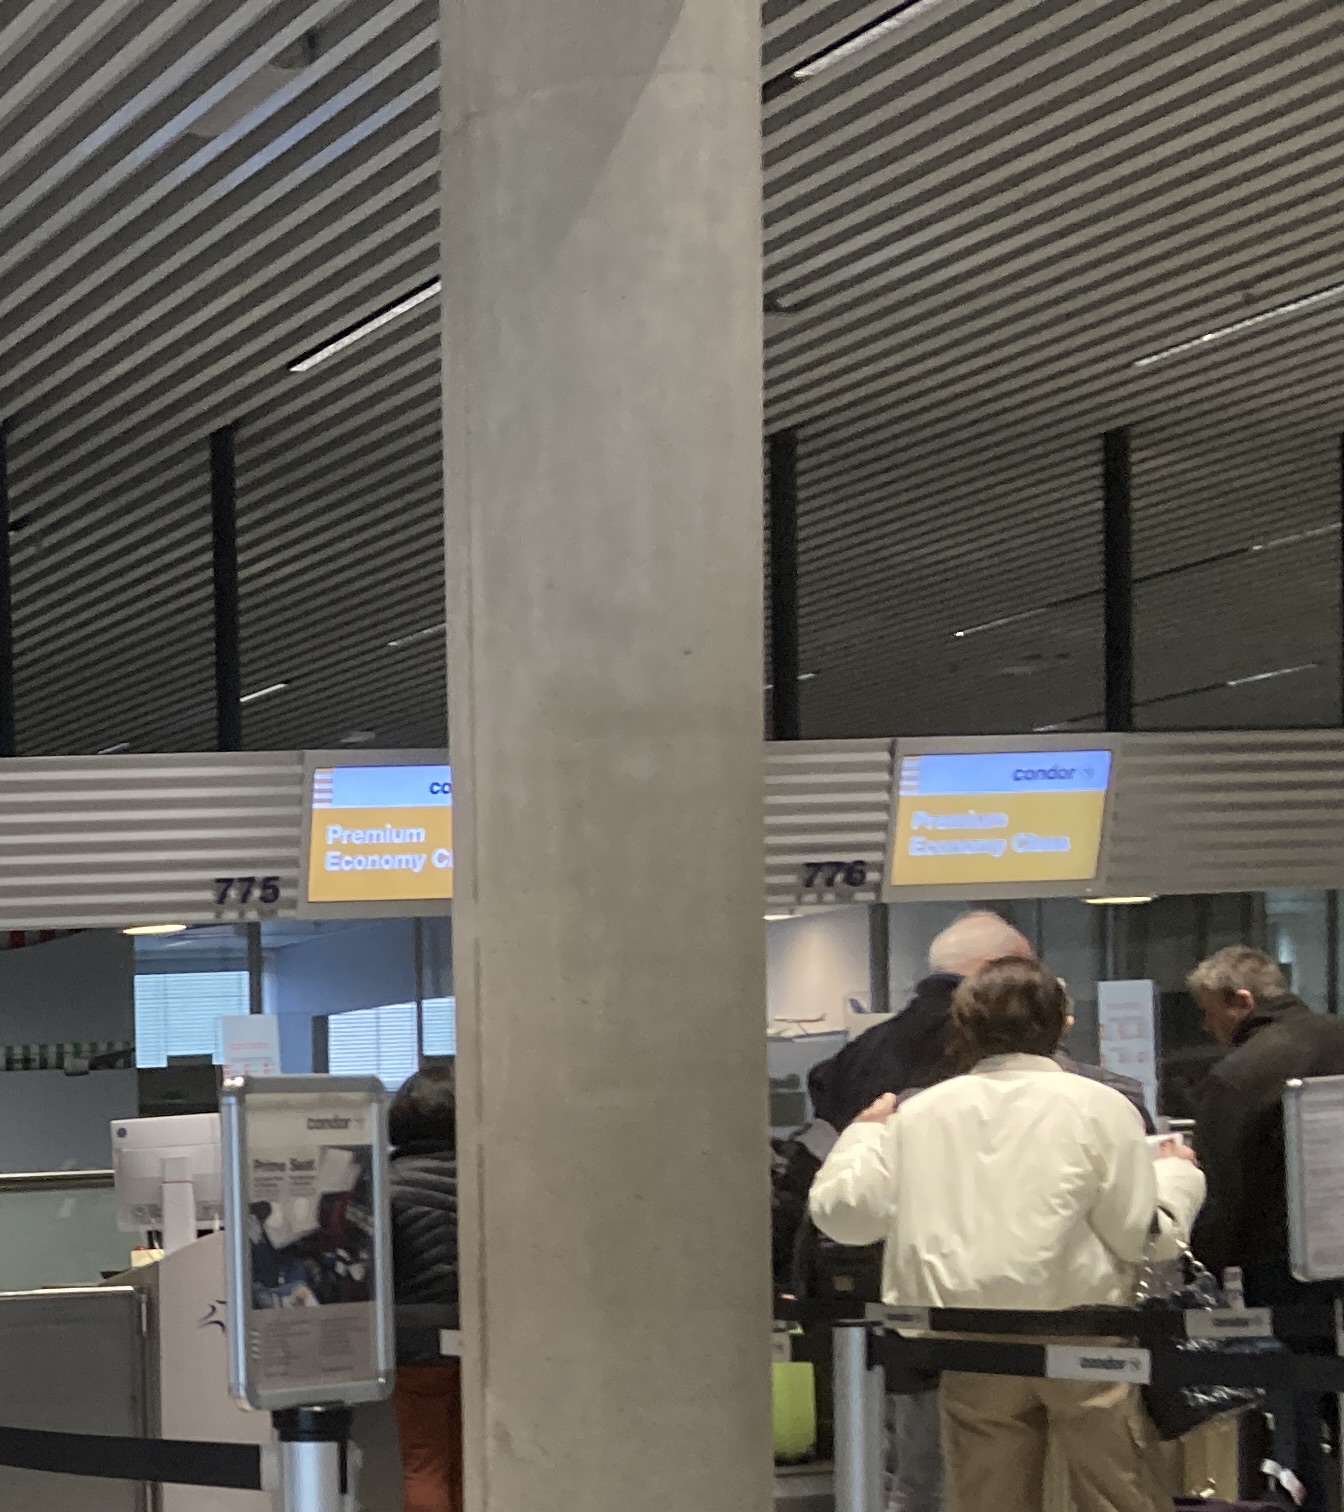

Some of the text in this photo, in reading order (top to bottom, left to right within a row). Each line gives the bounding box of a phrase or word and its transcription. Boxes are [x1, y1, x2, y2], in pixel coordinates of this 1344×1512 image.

[325, 824, 426, 845] Premium
[324, 852, 426, 873] Economy
[802, 860, 866, 888] 776
[215, 876, 280, 904] 775
